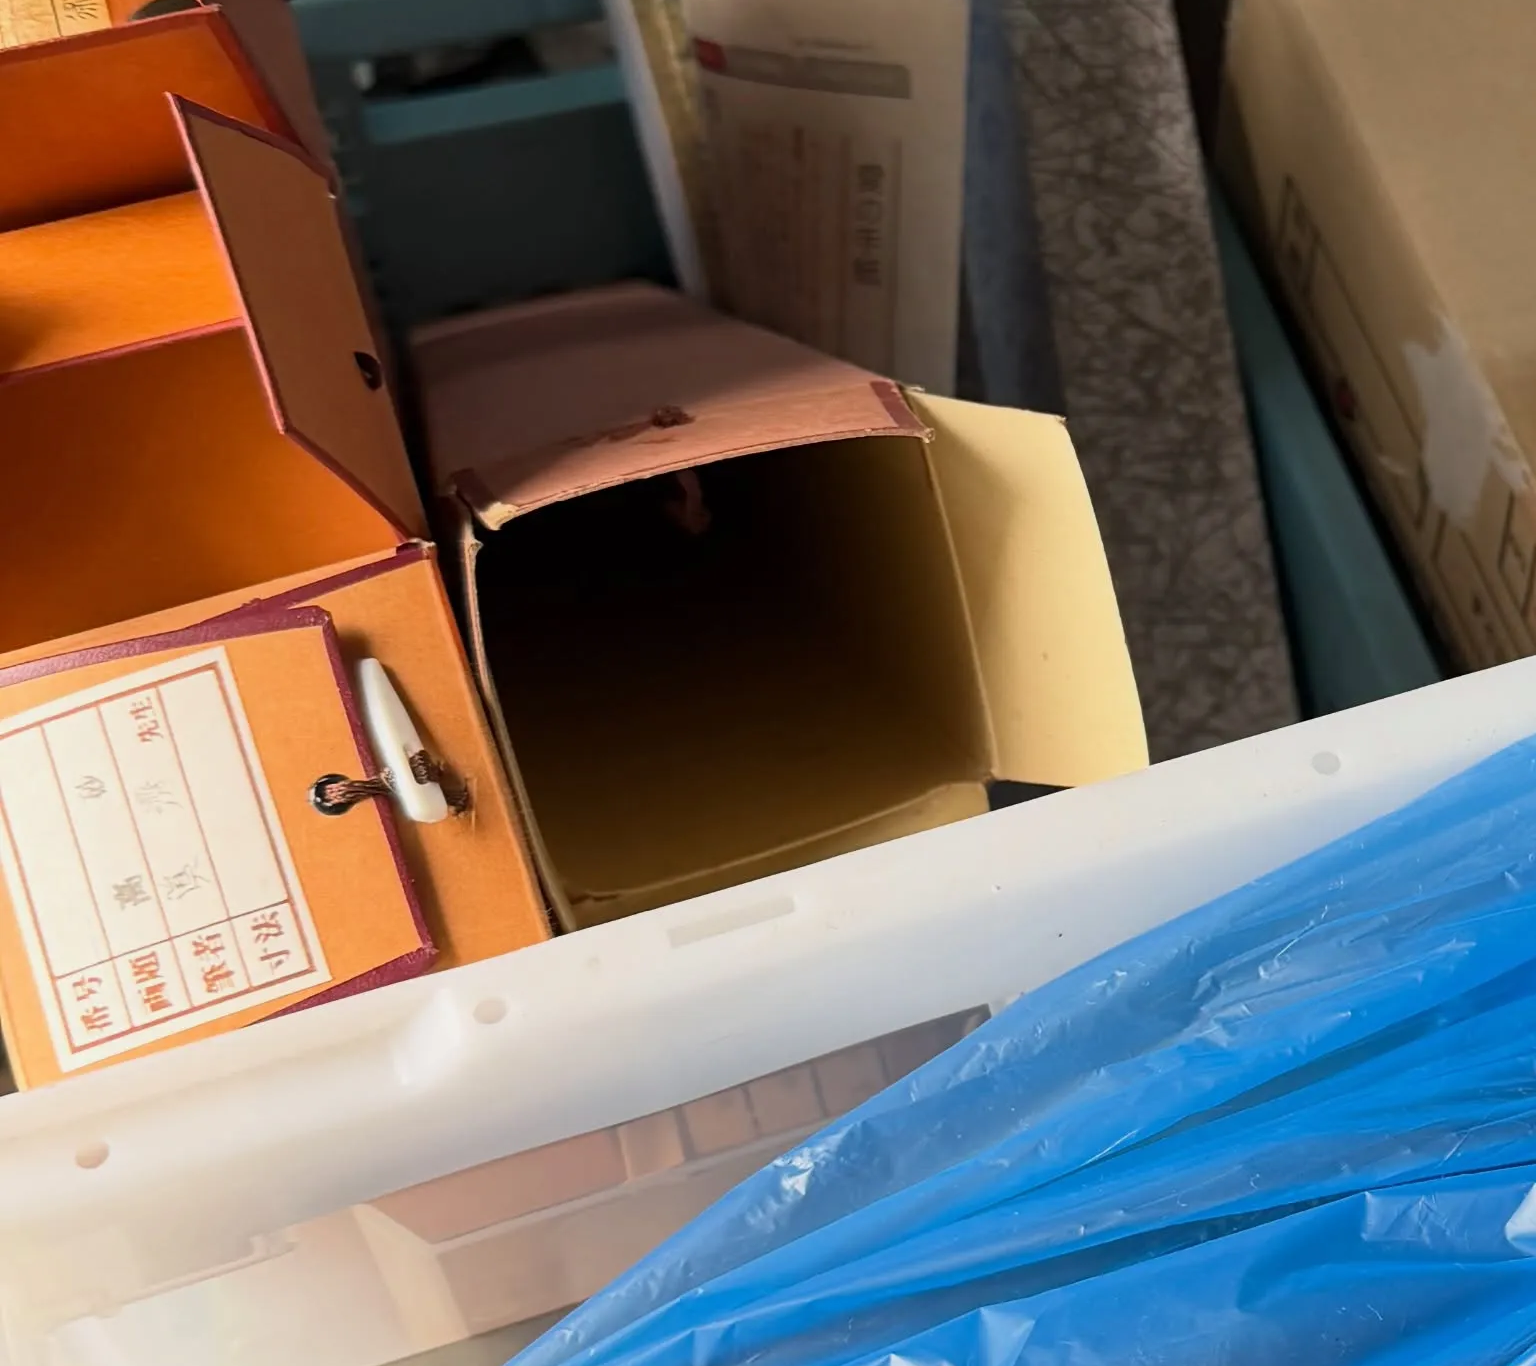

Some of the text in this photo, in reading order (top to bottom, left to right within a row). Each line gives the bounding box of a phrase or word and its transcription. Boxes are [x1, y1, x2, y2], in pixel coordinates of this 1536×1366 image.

[129, 696, 164, 744] 先生
[192, 932, 235, 994] 筆者
[251, 910, 291, 975] 寸法
[73, 975, 115, 1033] 番号
[132, 950, 174, 1014] 画題
